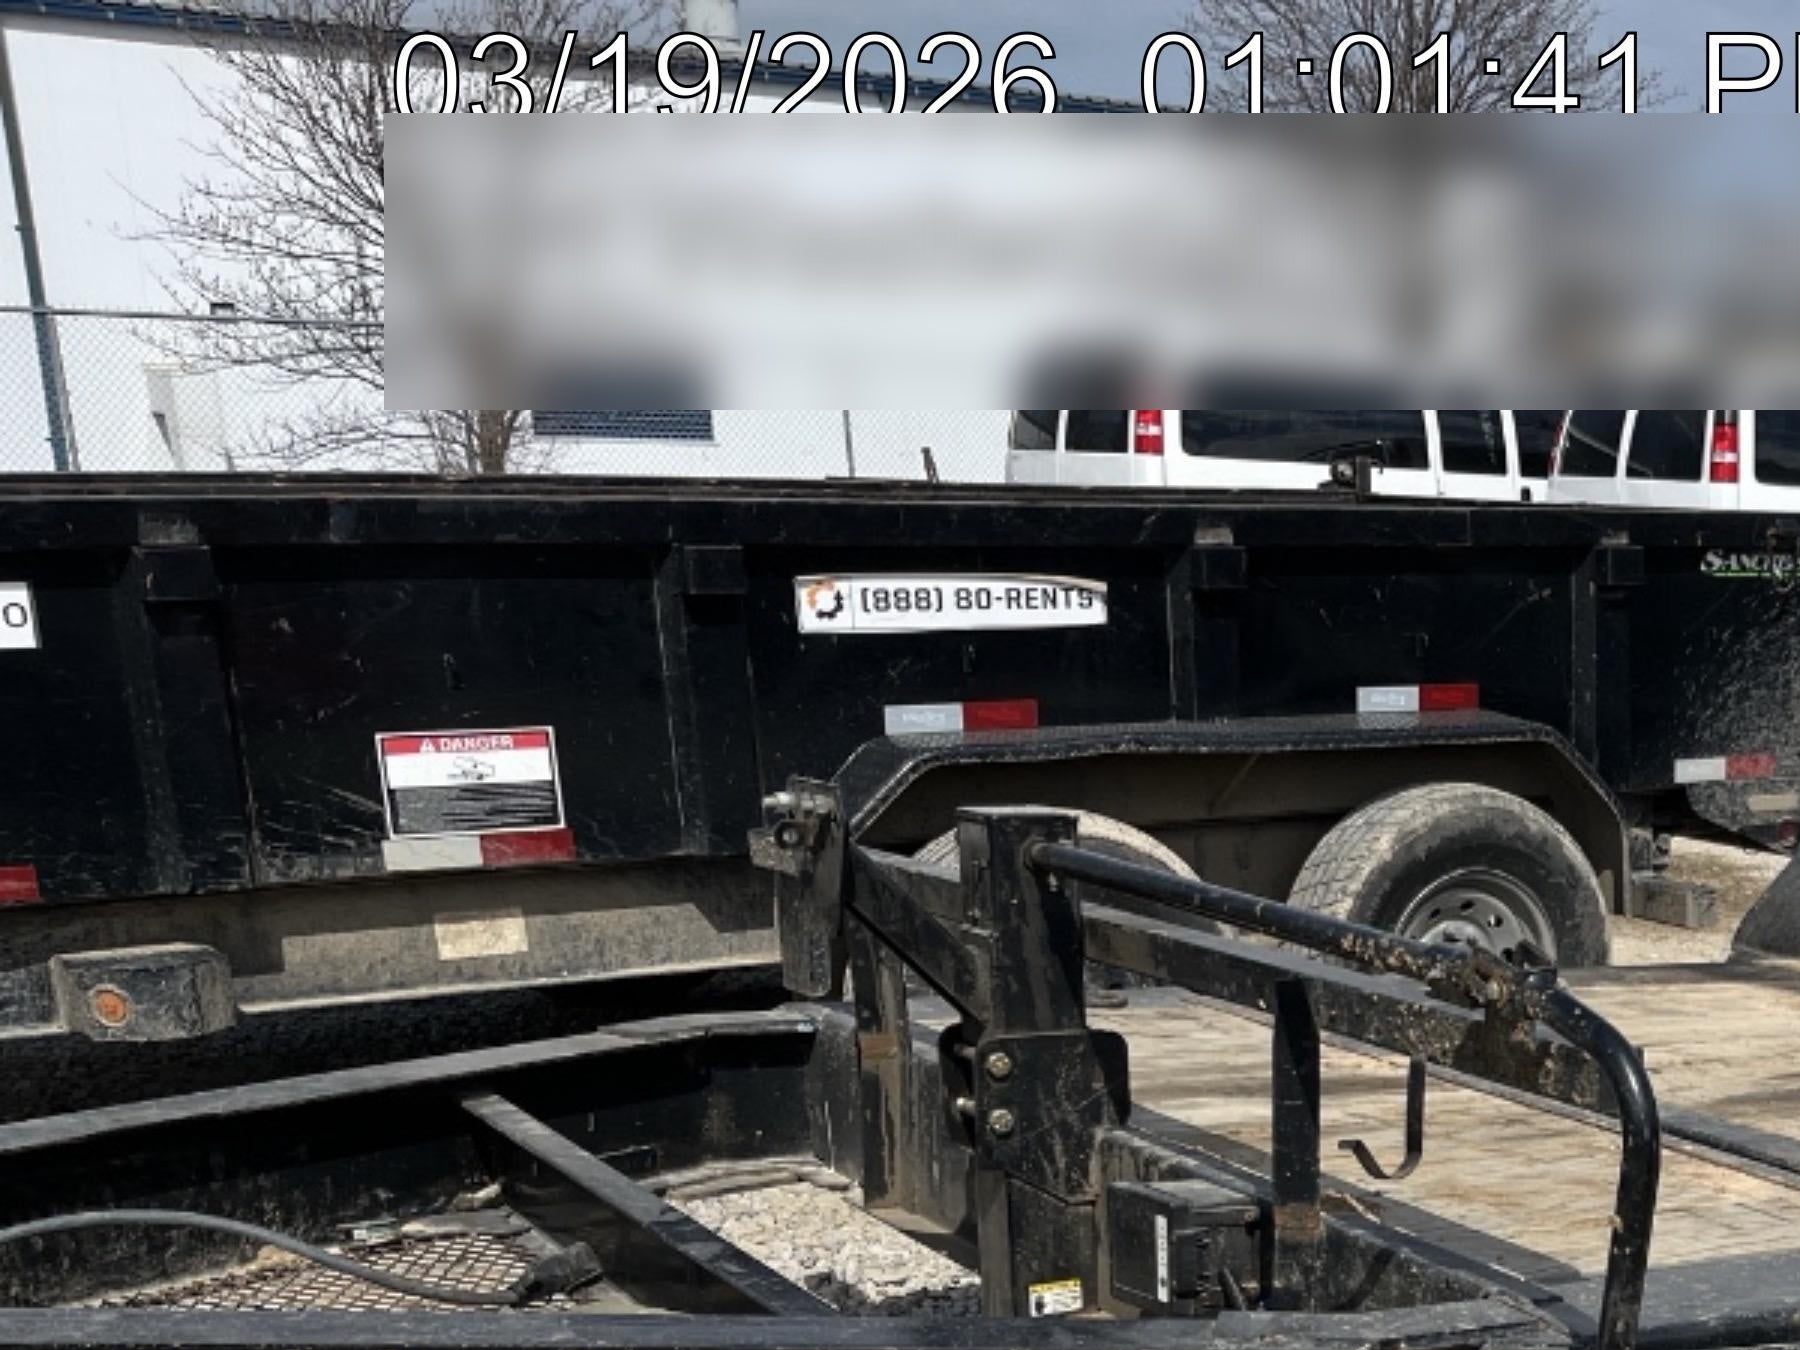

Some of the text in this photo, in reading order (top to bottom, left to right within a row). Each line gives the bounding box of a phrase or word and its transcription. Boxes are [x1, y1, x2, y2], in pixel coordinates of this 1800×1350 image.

[860, 586, 1094, 613] (888) 80-RENTS
[440, 735, 514, 752] DANGER
